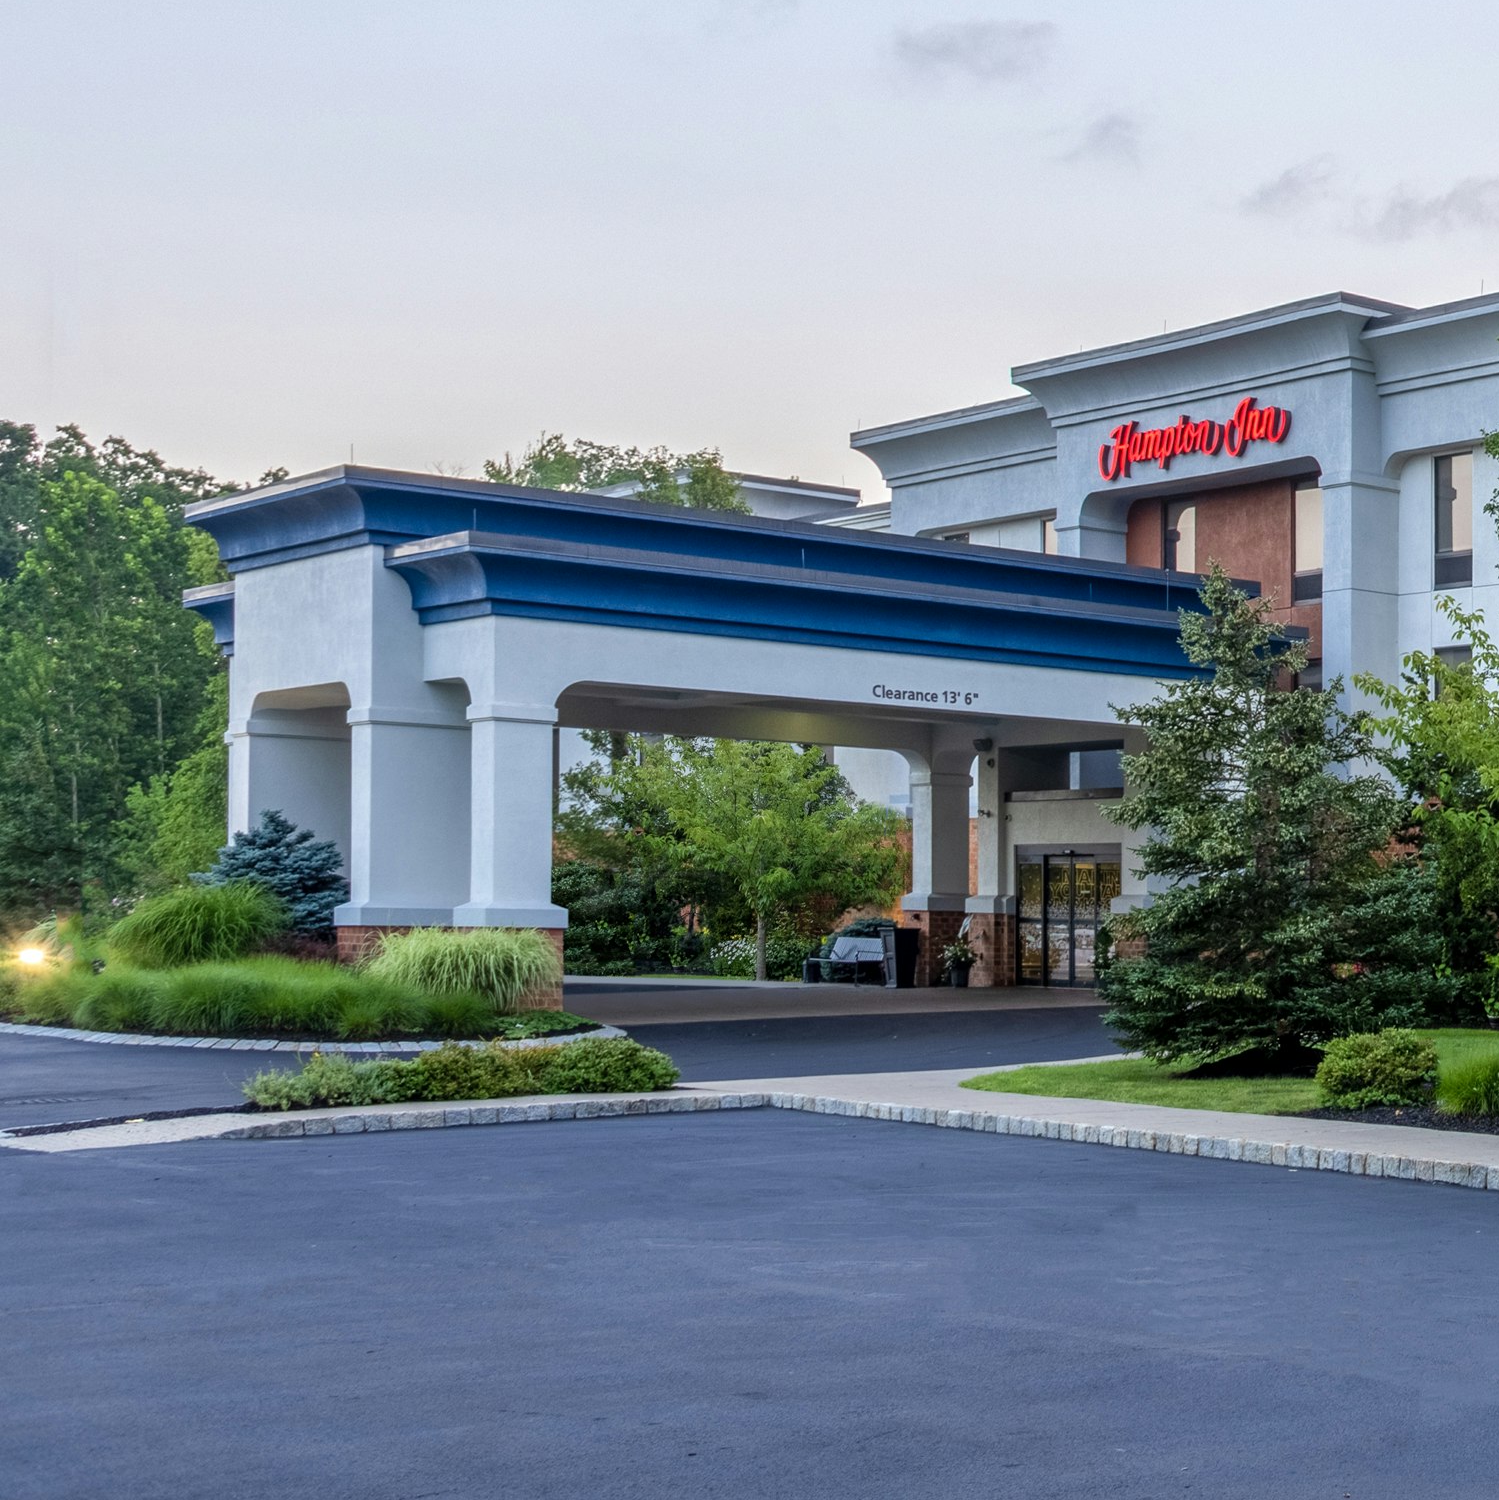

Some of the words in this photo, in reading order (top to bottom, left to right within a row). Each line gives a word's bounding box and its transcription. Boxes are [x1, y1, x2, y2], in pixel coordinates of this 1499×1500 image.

[1098, 414, 1224, 482] Hampton
[1224, 396, 1292, 457] Inn
[872, 684, 938, 703] Clearance
[942, 690, 961, 704] 13'
[964, 692, 979, 706] 6"
